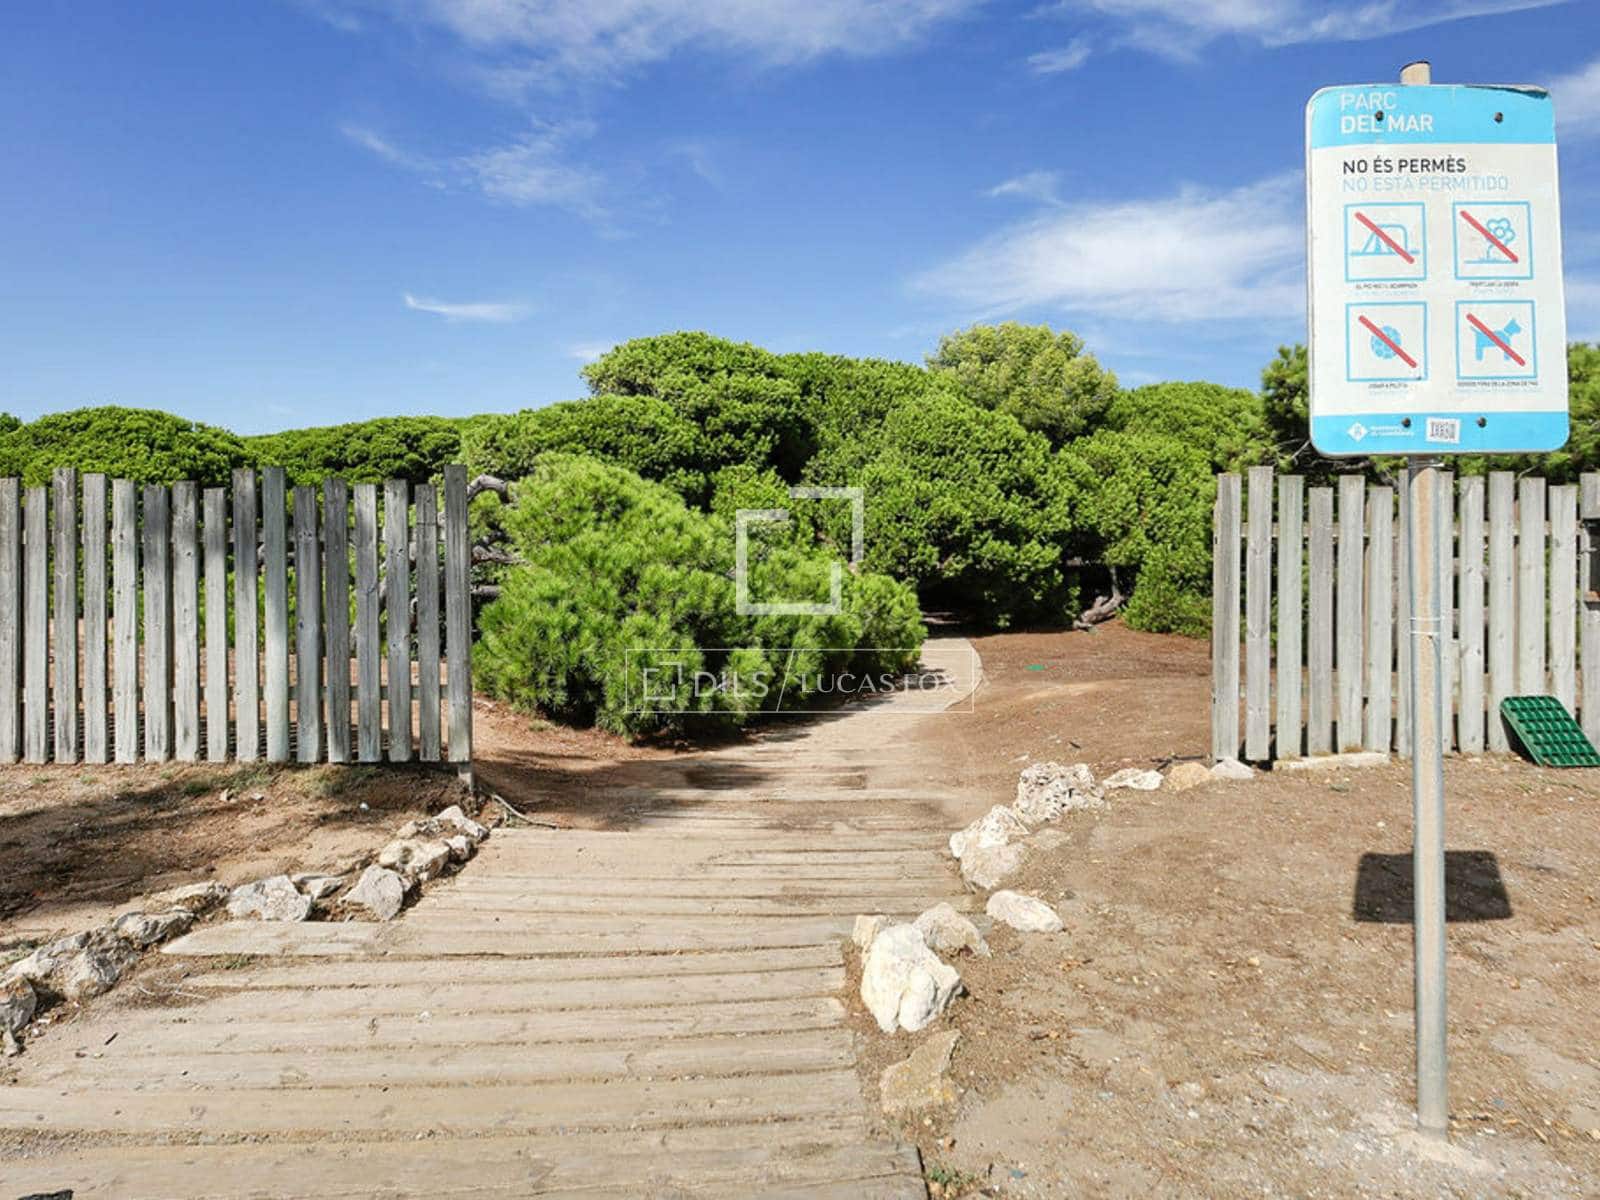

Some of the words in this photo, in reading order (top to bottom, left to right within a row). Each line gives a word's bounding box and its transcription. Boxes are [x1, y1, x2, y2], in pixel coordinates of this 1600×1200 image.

[1340, 92, 1397, 111] PARC
[1341, 115, 1383, 134] DEL
[1387, 114, 1433, 133] MAR
[1343, 159, 1368, 175] NO
[1373, 155, 1393, 173] ÉS
[1398, 154, 1466, 173] PERMÈS
[1343, 177, 1368, 192] NO
[1418, 175, 1509, 191] PERMITIDO
